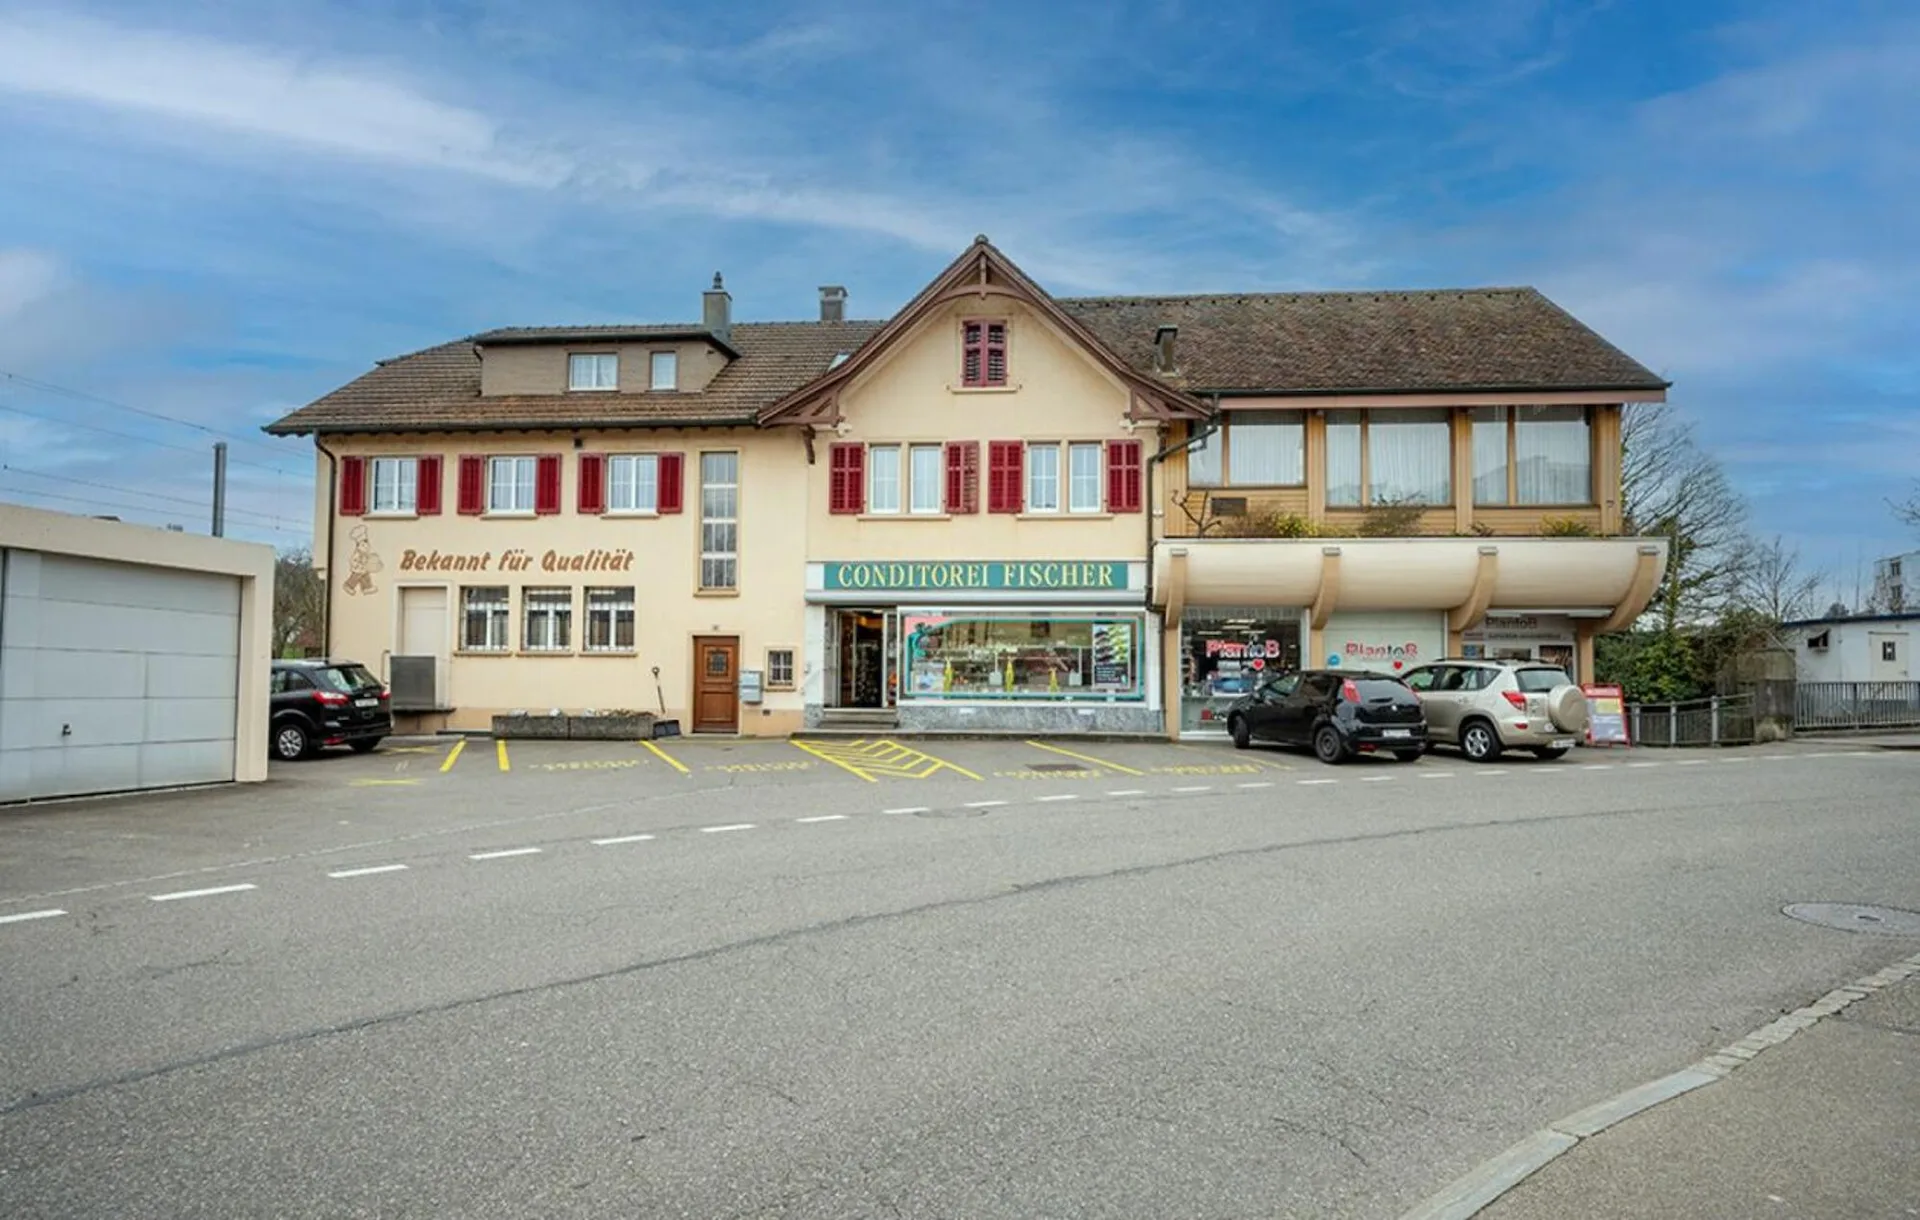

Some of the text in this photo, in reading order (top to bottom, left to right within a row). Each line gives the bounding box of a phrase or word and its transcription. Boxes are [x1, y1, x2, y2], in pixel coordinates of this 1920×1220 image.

[400, 549, 634, 572] Bekannt für Qualität
[838, 563, 1113, 588] CONDITOREI FISCHER
